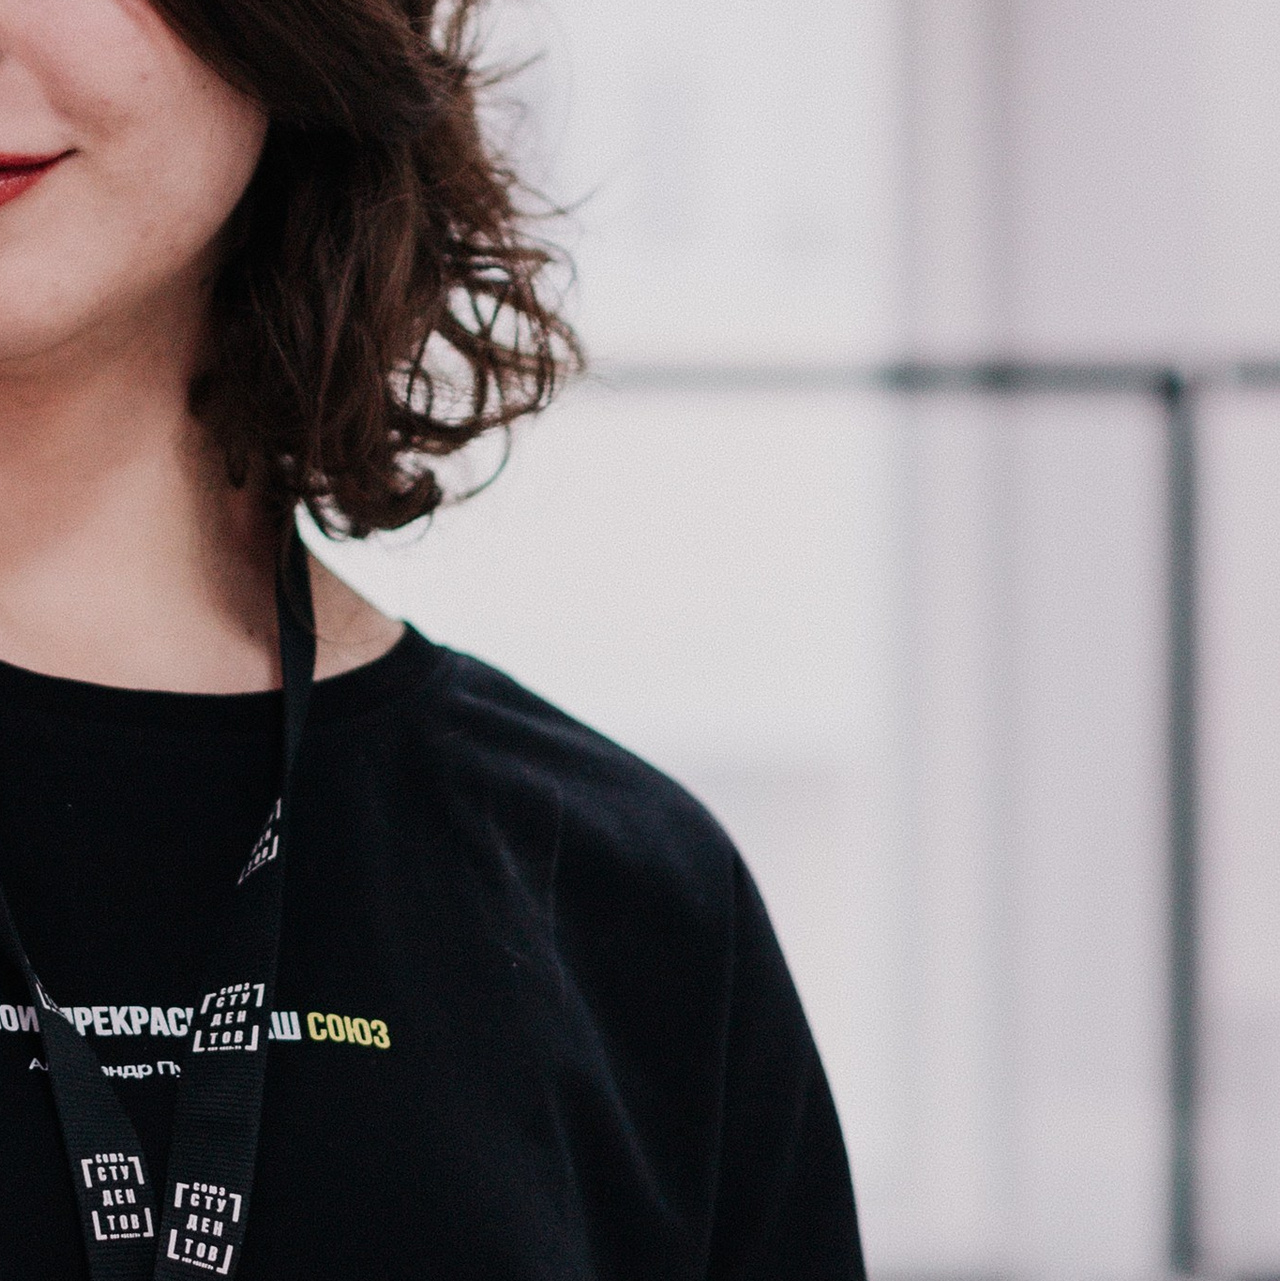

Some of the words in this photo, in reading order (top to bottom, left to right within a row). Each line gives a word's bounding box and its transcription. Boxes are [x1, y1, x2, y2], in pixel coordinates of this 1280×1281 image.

[216, 992, 251, 1008] СТУ
[210, 1010, 247, 1027] ДЕН
[210, 1030, 244, 1045] ТОВ
[307, 1011, 391, 1049] СОЮЗ
[97, 1165, 129, 1181] СТУ
[102, 1188, 136, 1206] ДЕН
[190, 1193, 227, 1213] СТУ
[106, 1213, 140, 1231] ТОВ
[186, 1213, 224, 1237] ДЕН
[184, 1238, 218, 1262] ТОВ
